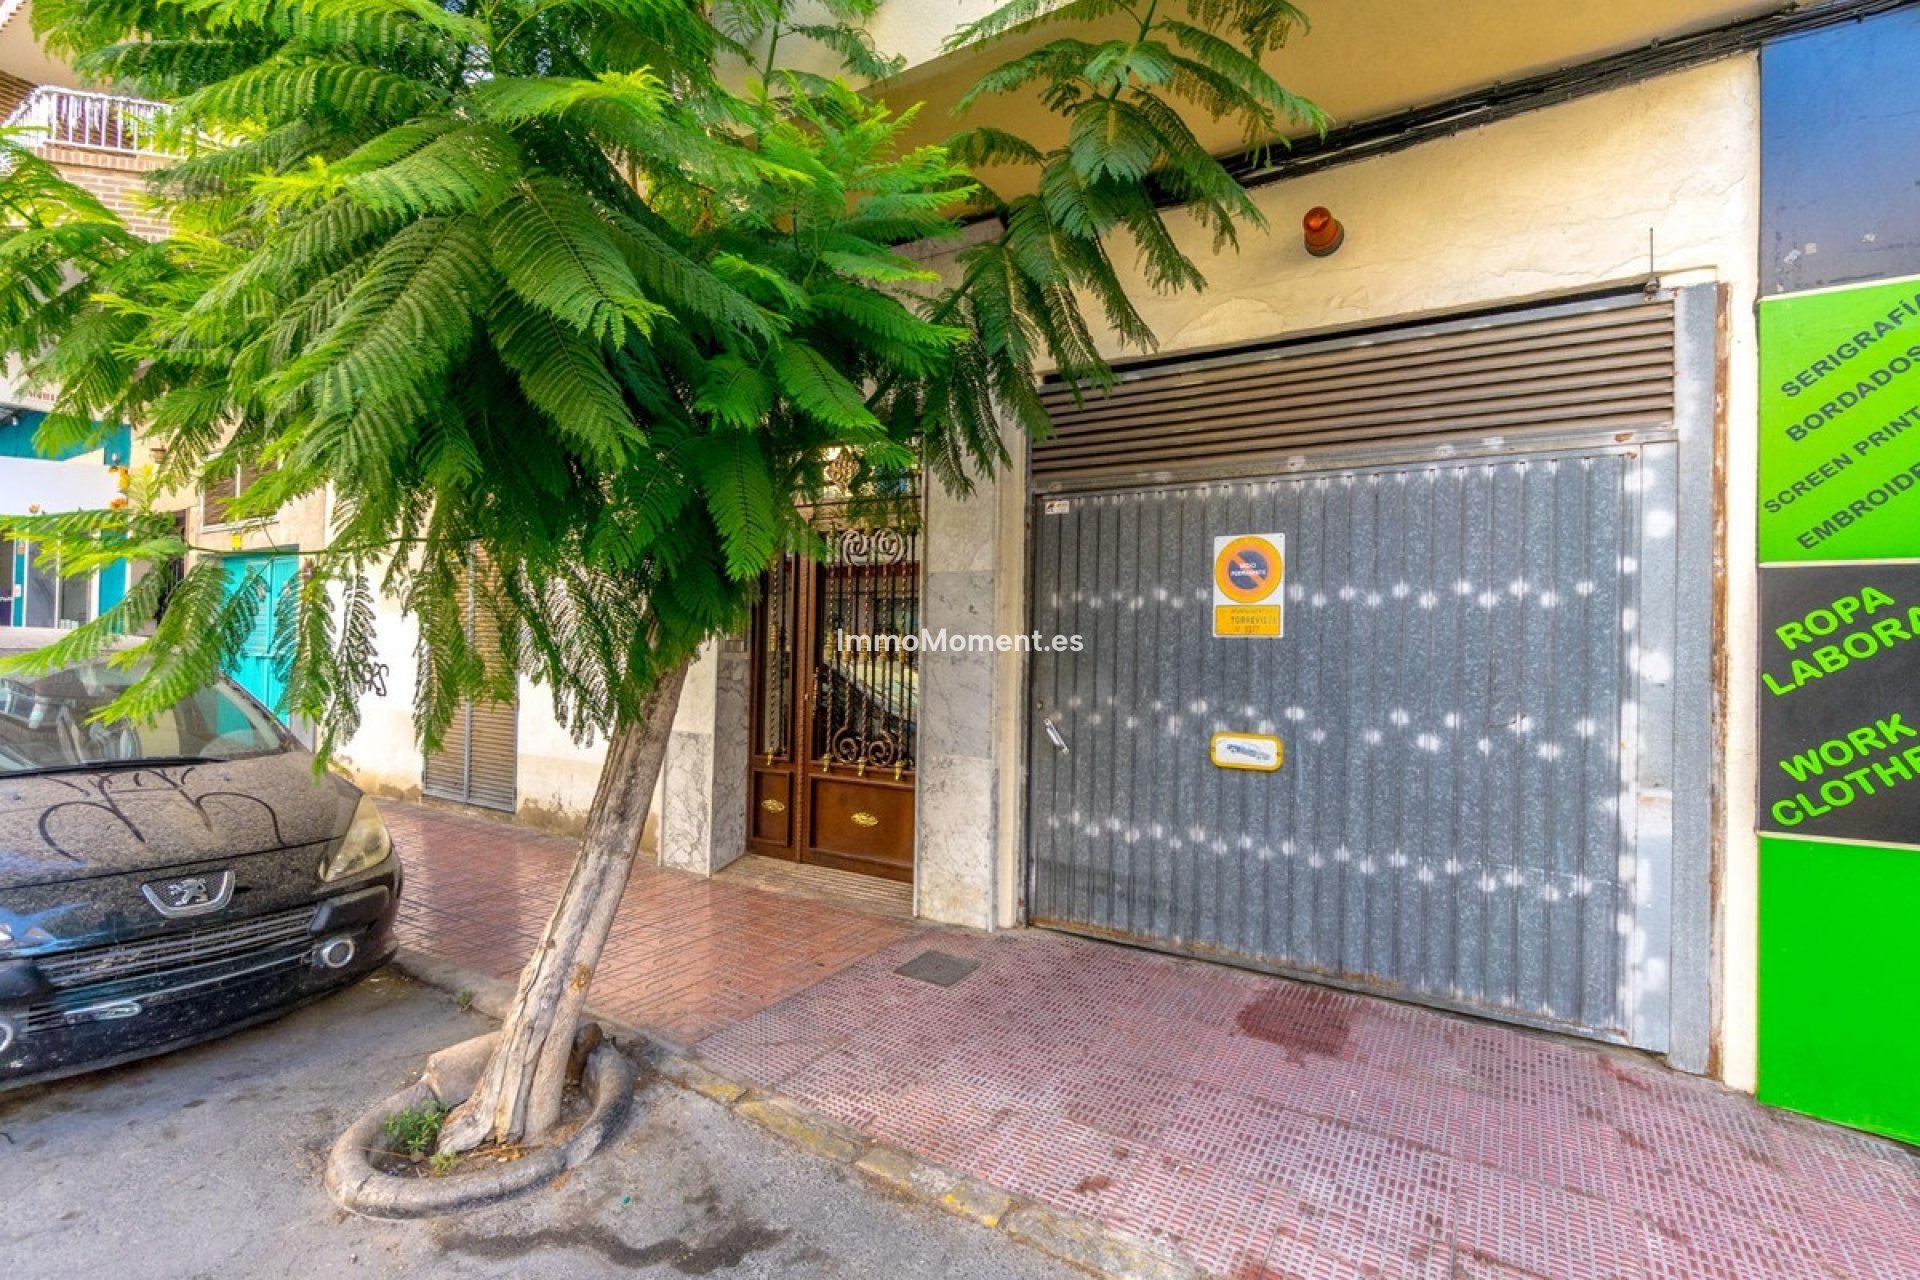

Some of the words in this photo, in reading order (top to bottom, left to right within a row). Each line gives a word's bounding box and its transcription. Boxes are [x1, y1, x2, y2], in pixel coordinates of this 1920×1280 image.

[1786, 345, 1920, 442] BORDADOS
[1764, 453, 1853, 513] SCREEN
[1853, 405, 1920, 456] PRINT
[1776, 586, 1895, 650] ROPA
[1779, 713, 1917, 781] WORK
